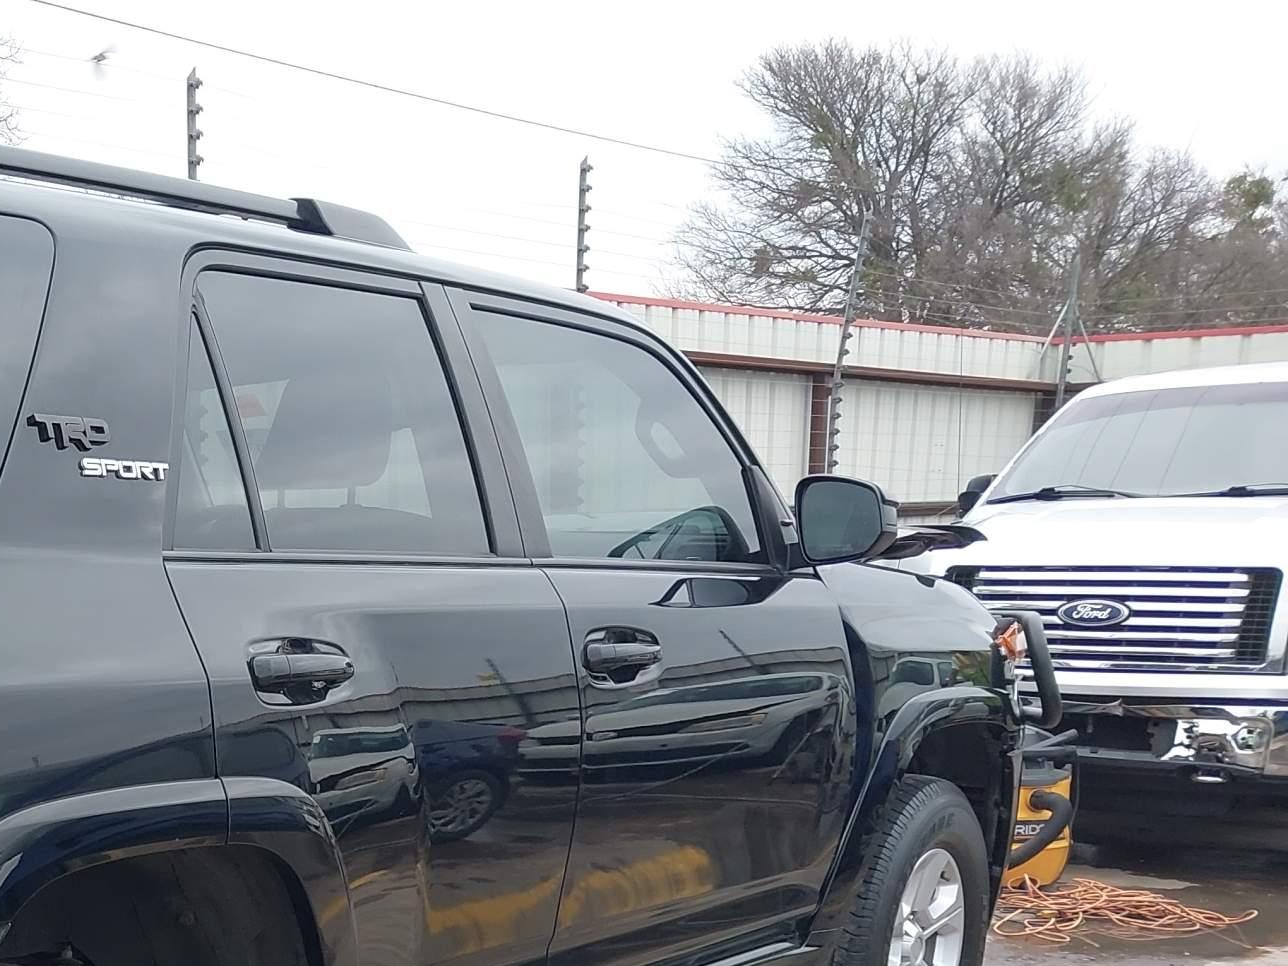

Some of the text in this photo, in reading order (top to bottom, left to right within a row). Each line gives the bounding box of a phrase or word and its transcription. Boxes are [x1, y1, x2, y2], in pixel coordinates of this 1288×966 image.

[26, 413, 111, 451] TRD
[79, 457, 169, 481] SPORT
[1072, 603, 1112, 619] Ford
[1014, 823, 1046, 836] RID
